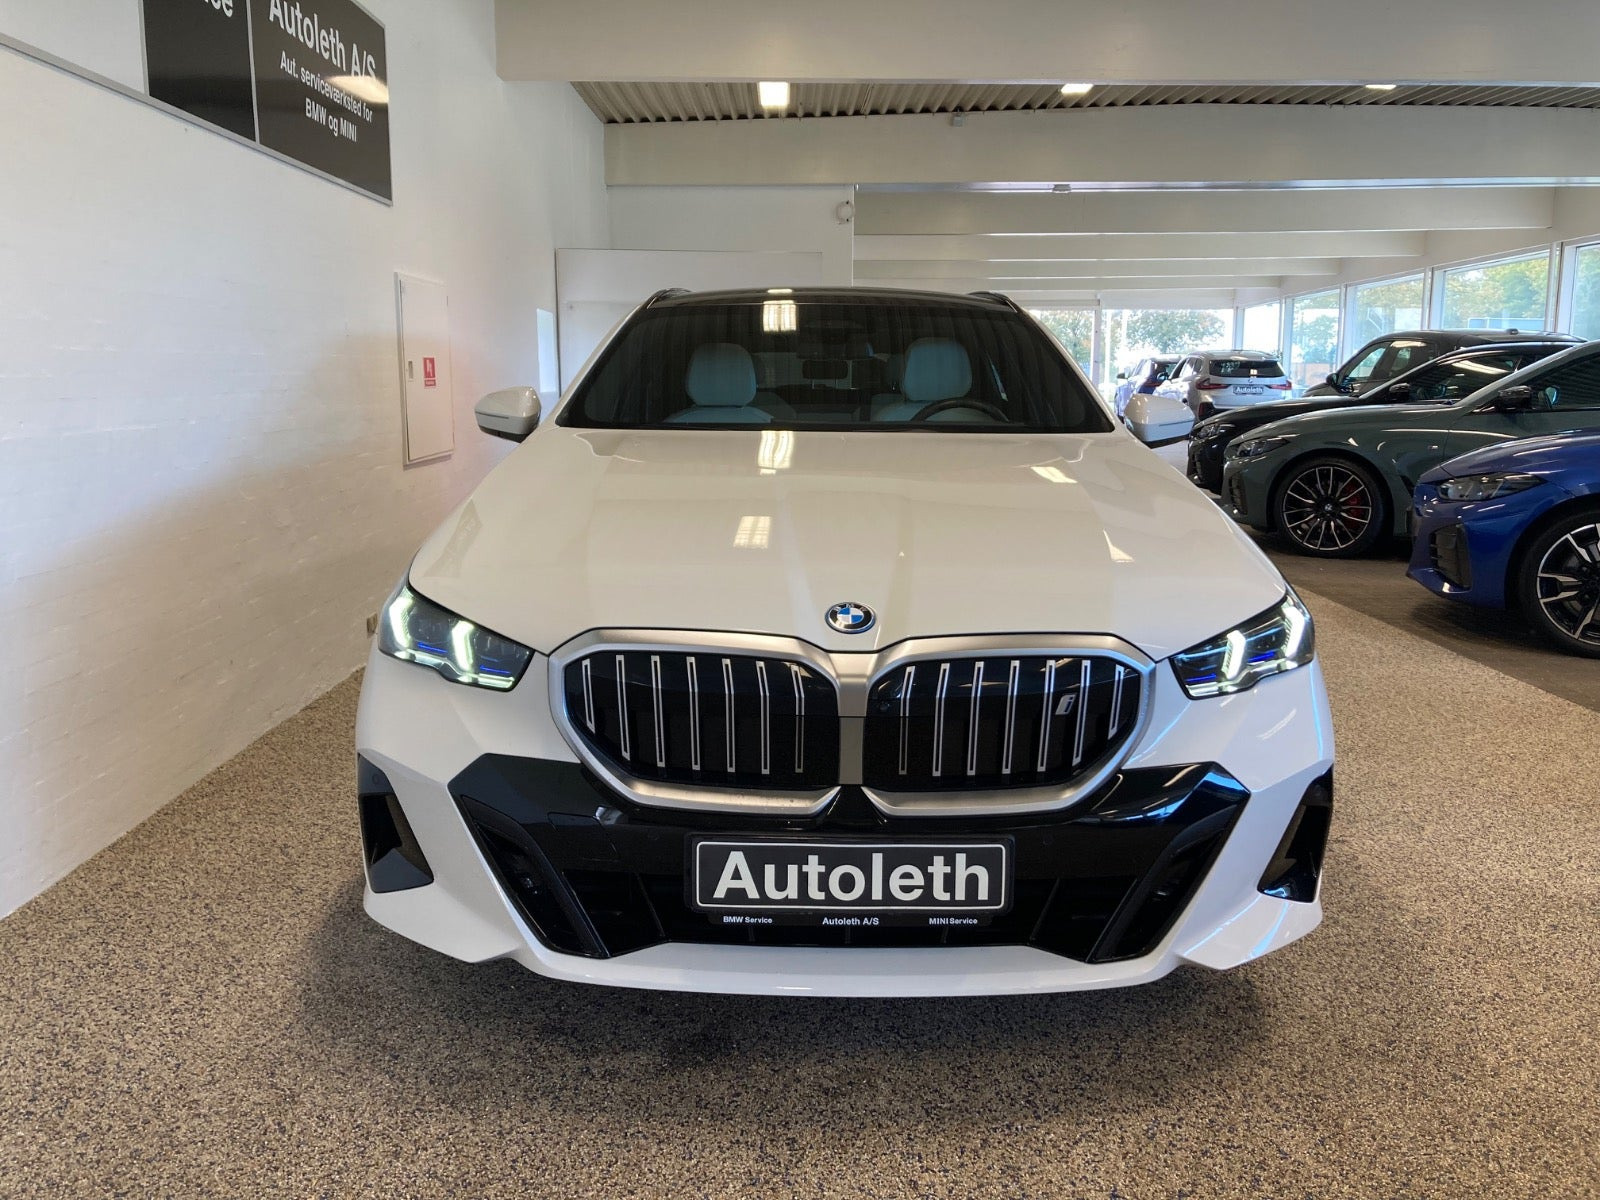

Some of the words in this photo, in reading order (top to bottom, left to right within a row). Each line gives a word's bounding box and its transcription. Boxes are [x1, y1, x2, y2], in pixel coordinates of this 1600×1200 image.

[269, 0, 346, 72] Autoleth
[351, 43, 376, 81] A/S
[280, 50, 299, 79] Aut.
[300, 67, 362, 117] serviceværksted
[363, 102, 373, 123] for
[305, 97, 327, 126] BMW
[328, 115, 339, 137] og
[340, 117, 357, 142] MINI
[712, 850, 989, 901] Autoleth
[723, 915, 743, 923] BMW
[744, 916, 773, 924] Service
[822, 916, 860, 925] Autoleth
[862, 917, 880, 925] A/S
[929, 917, 949, 925] MINI
[950, 917, 978, 925] Service
